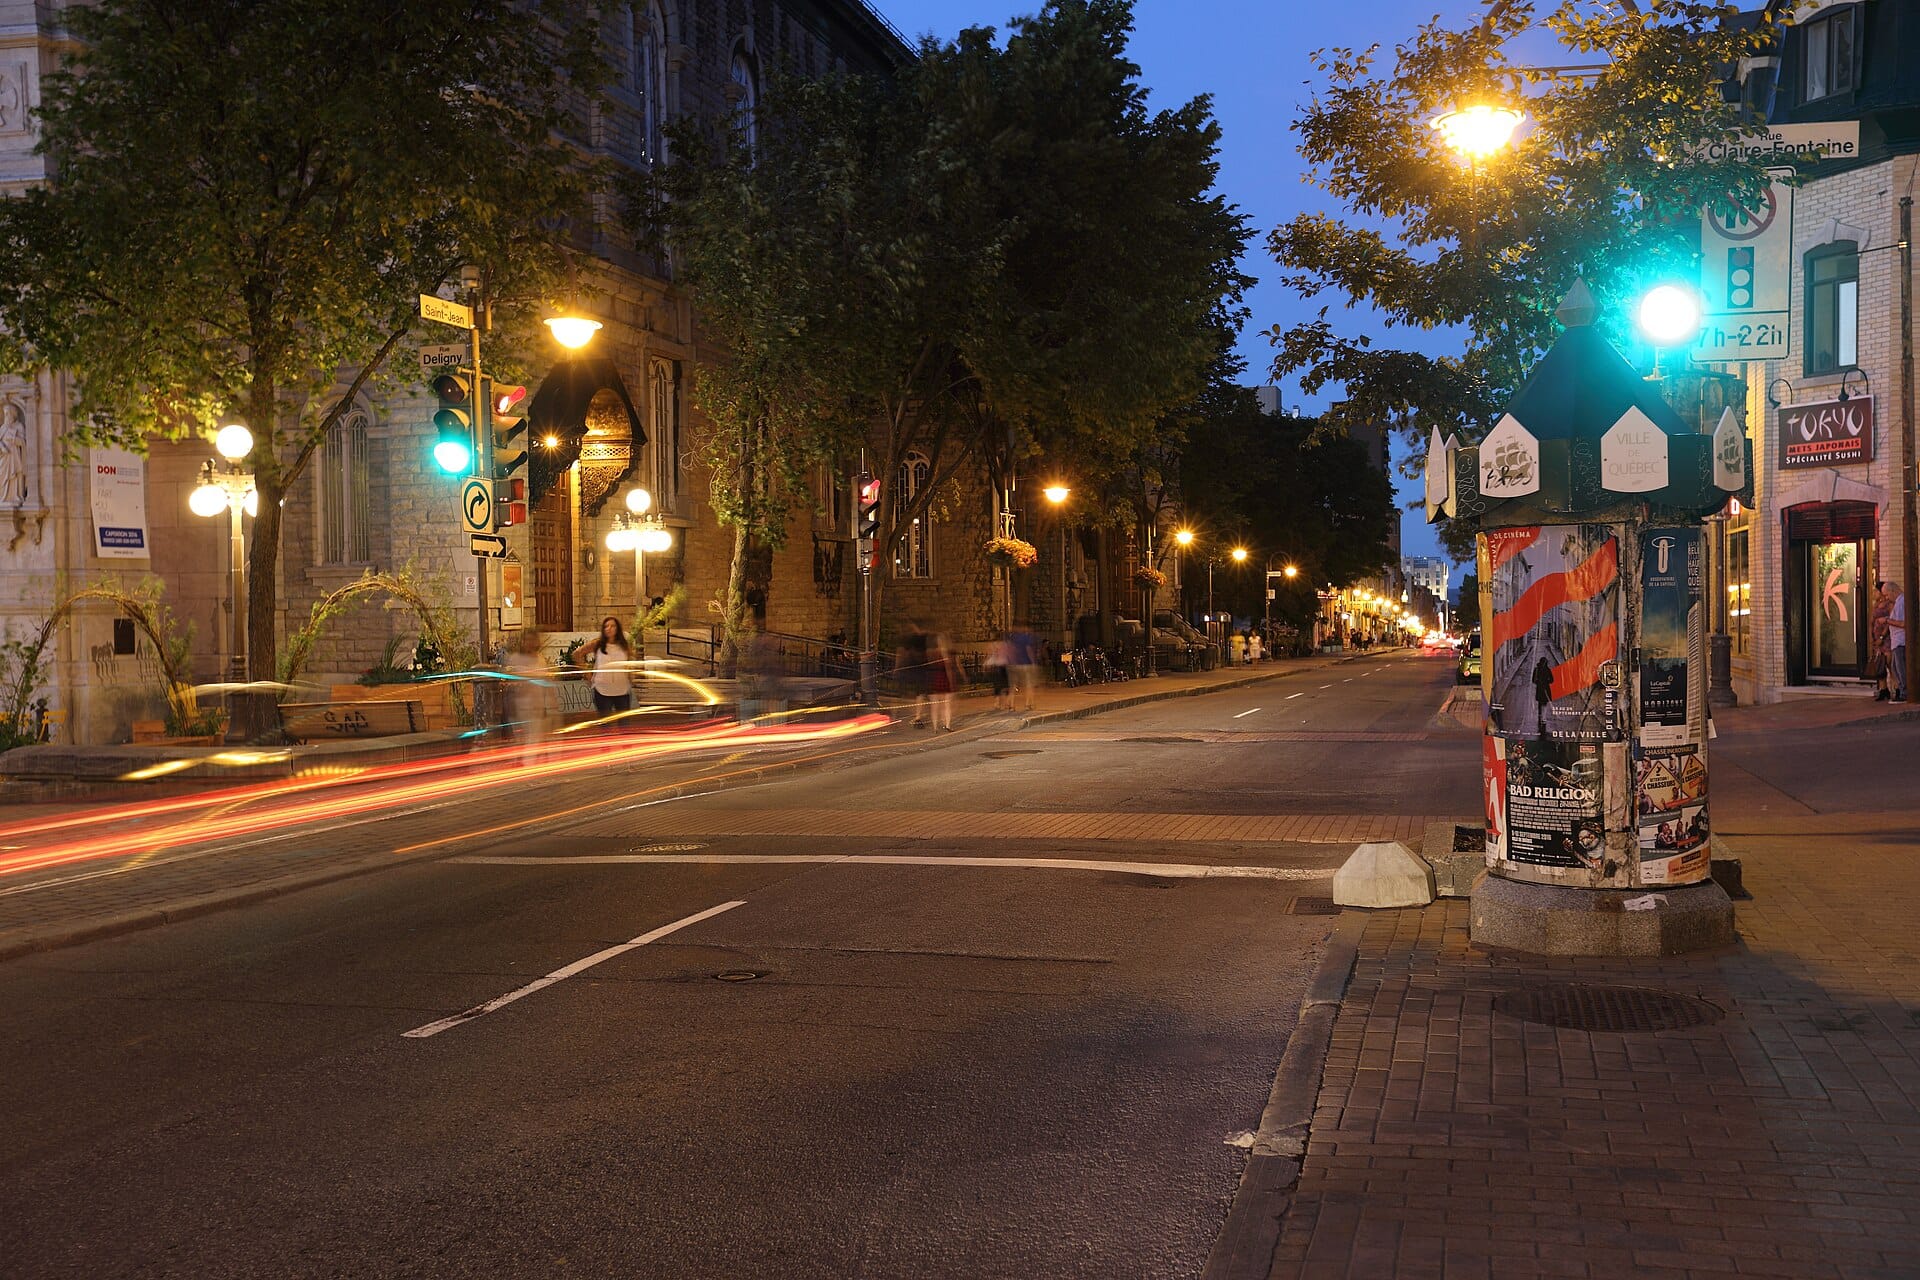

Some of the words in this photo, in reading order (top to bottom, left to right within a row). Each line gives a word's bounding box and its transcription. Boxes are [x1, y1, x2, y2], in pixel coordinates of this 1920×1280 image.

[1760, 132, 1782, 141] Rue
[1709, 138, 1854, 160] Claire-Fontaine
[425, 304, 465, 325] Saint-Jean
[423, 353, 463, 366] Deligny
[1616, 431, 1651, 445] VILLE
[1788, 445, 1812, 454] METS
[1815, 439, 1860, 451] JAPONAIS
[1628, 449, 1641, 457] DE
[1835, 450, 1861, 460] SUSHI
[97, 465, 117, 475] DON
[1503, 530, 1531, 539] CINÉMA
[1605, 719, 1613, 730] DE
[1646, 780, 1676, 790] CHASSEURS
[1510, 784, 1532, 797] BAD
[1534, 786, 1596, 800] RELIGION
